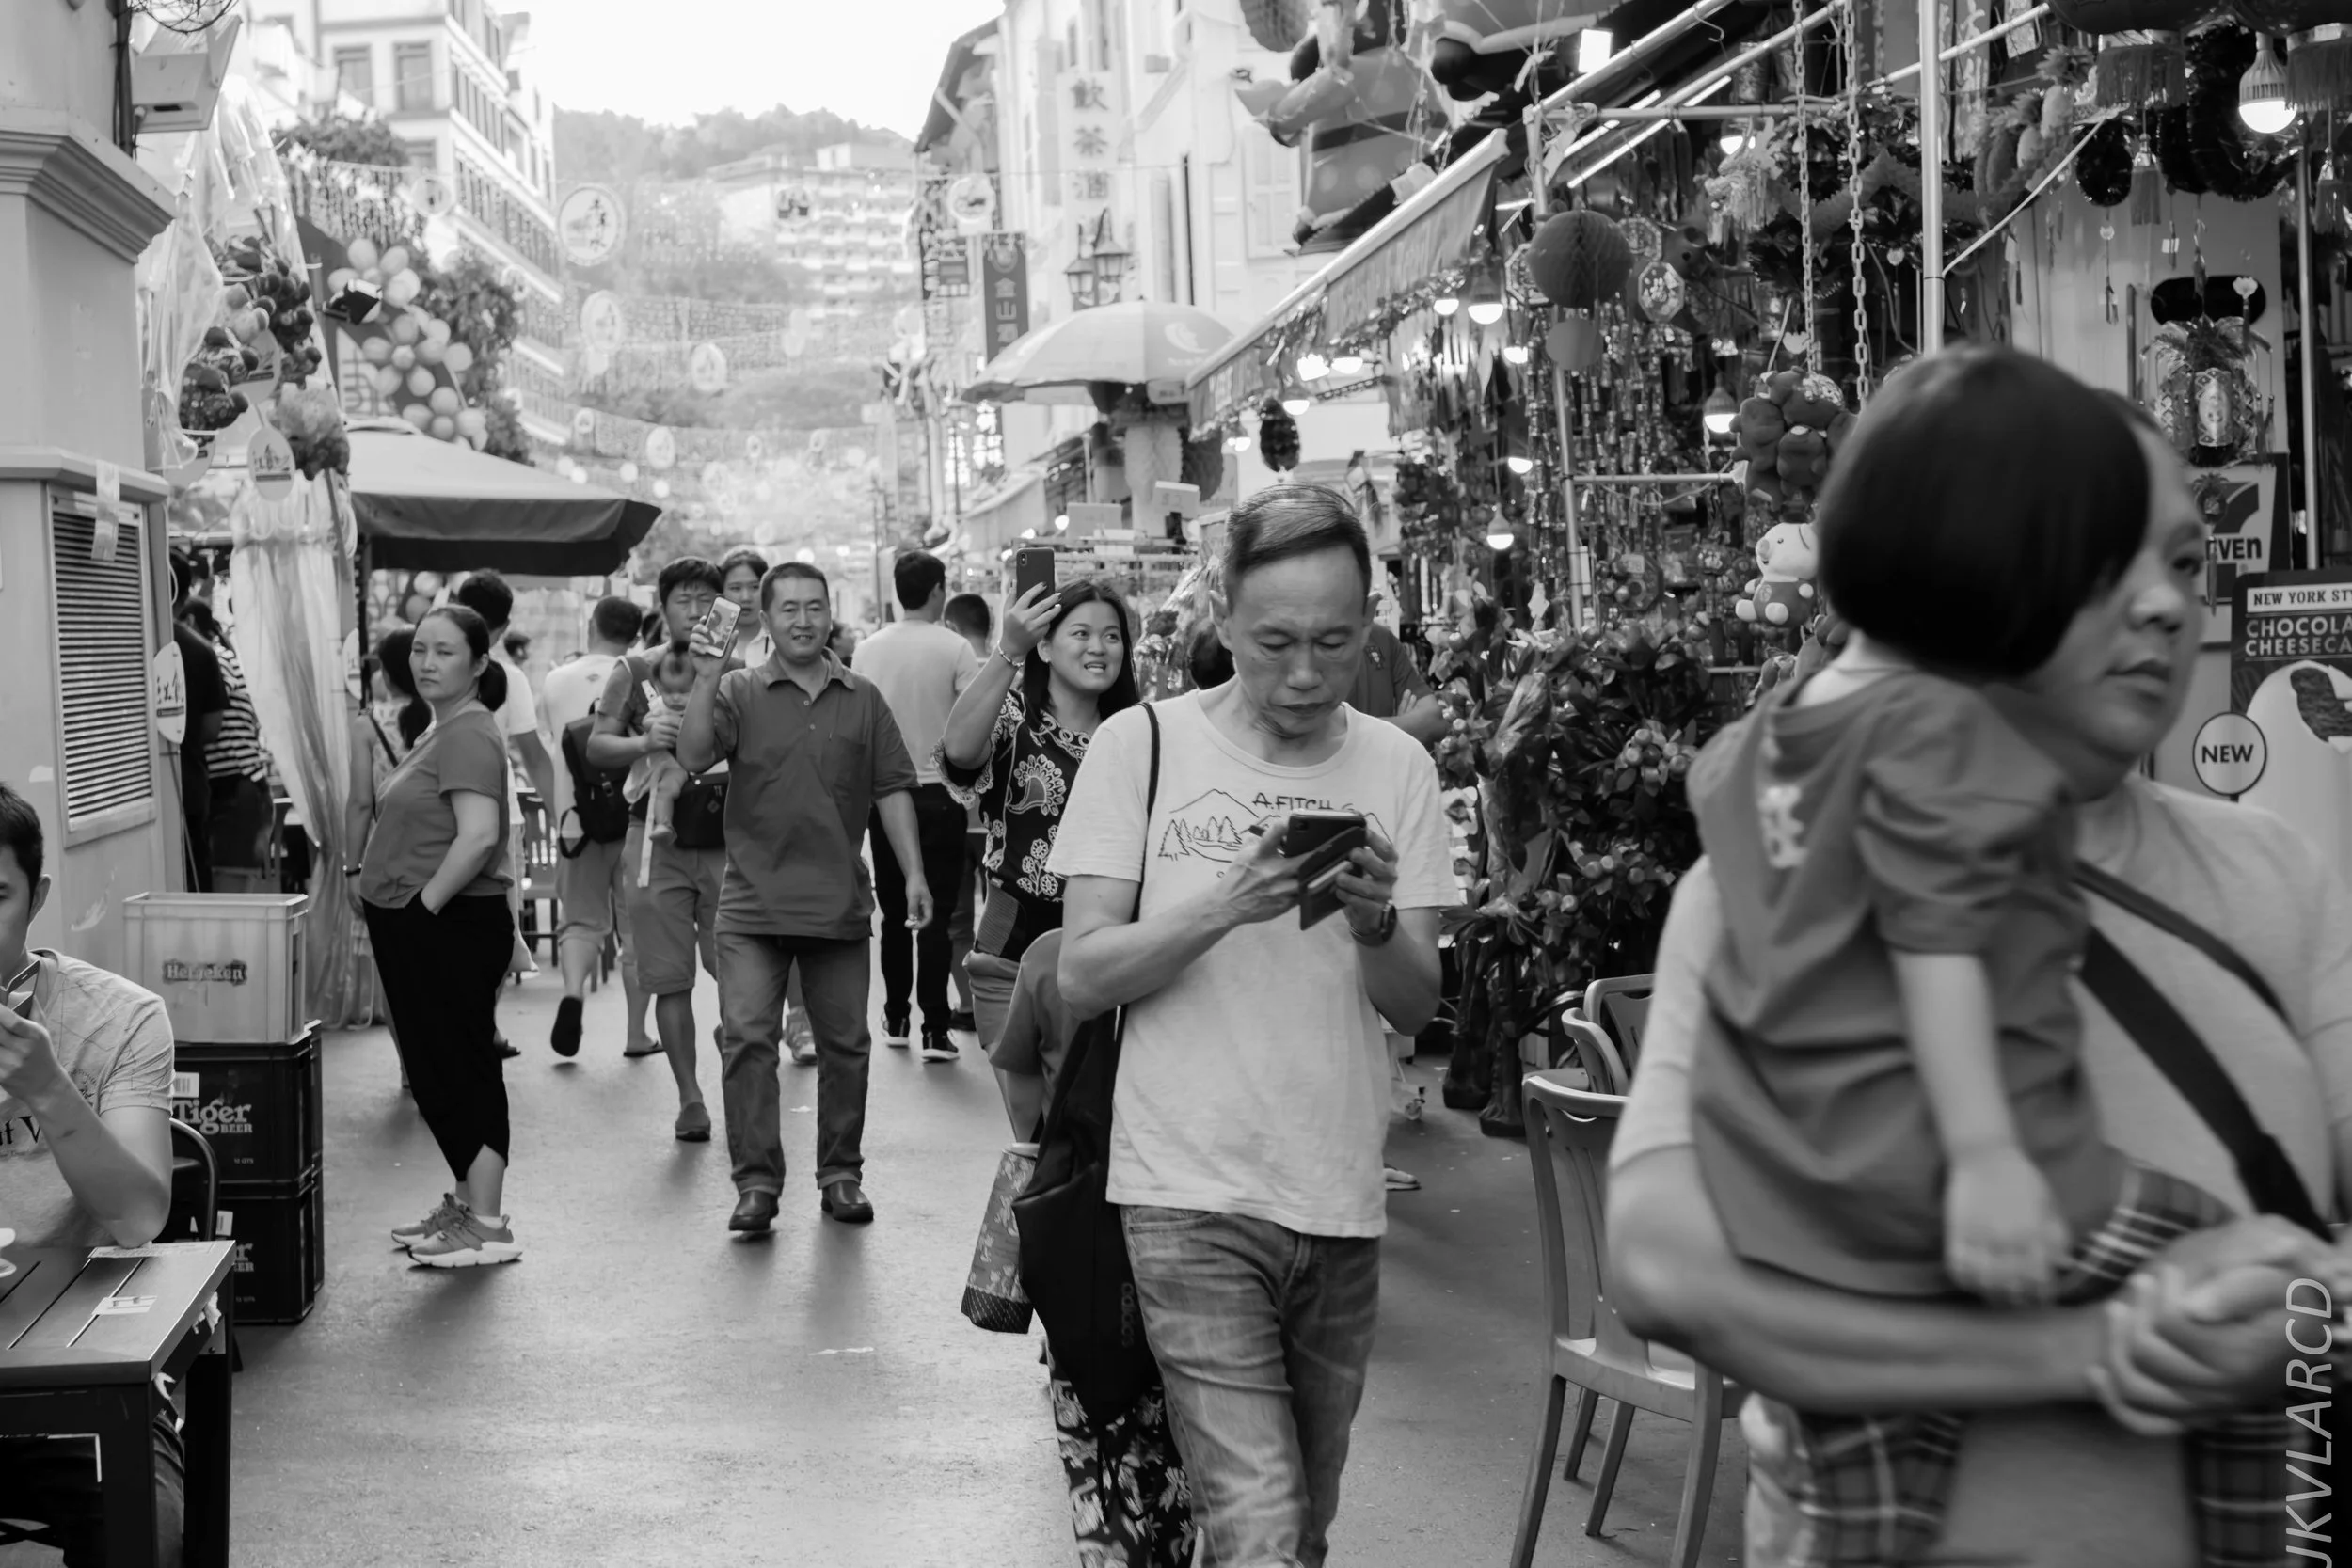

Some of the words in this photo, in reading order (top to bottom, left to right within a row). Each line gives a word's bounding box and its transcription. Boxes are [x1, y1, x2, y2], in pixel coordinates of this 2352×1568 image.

[2253, 593, 2283, 607] NEW
[2288, 590, 2327, 605] YORK
[2246, 614, 2352, 639] CHOCOLA
[2245, 635, 2352, 657] CHEESECA
[2201, 743, 2254, 764] NEW
[172, 1098, 252, 1136] Tiger
[220, 1122, 253, 1134] BEER
